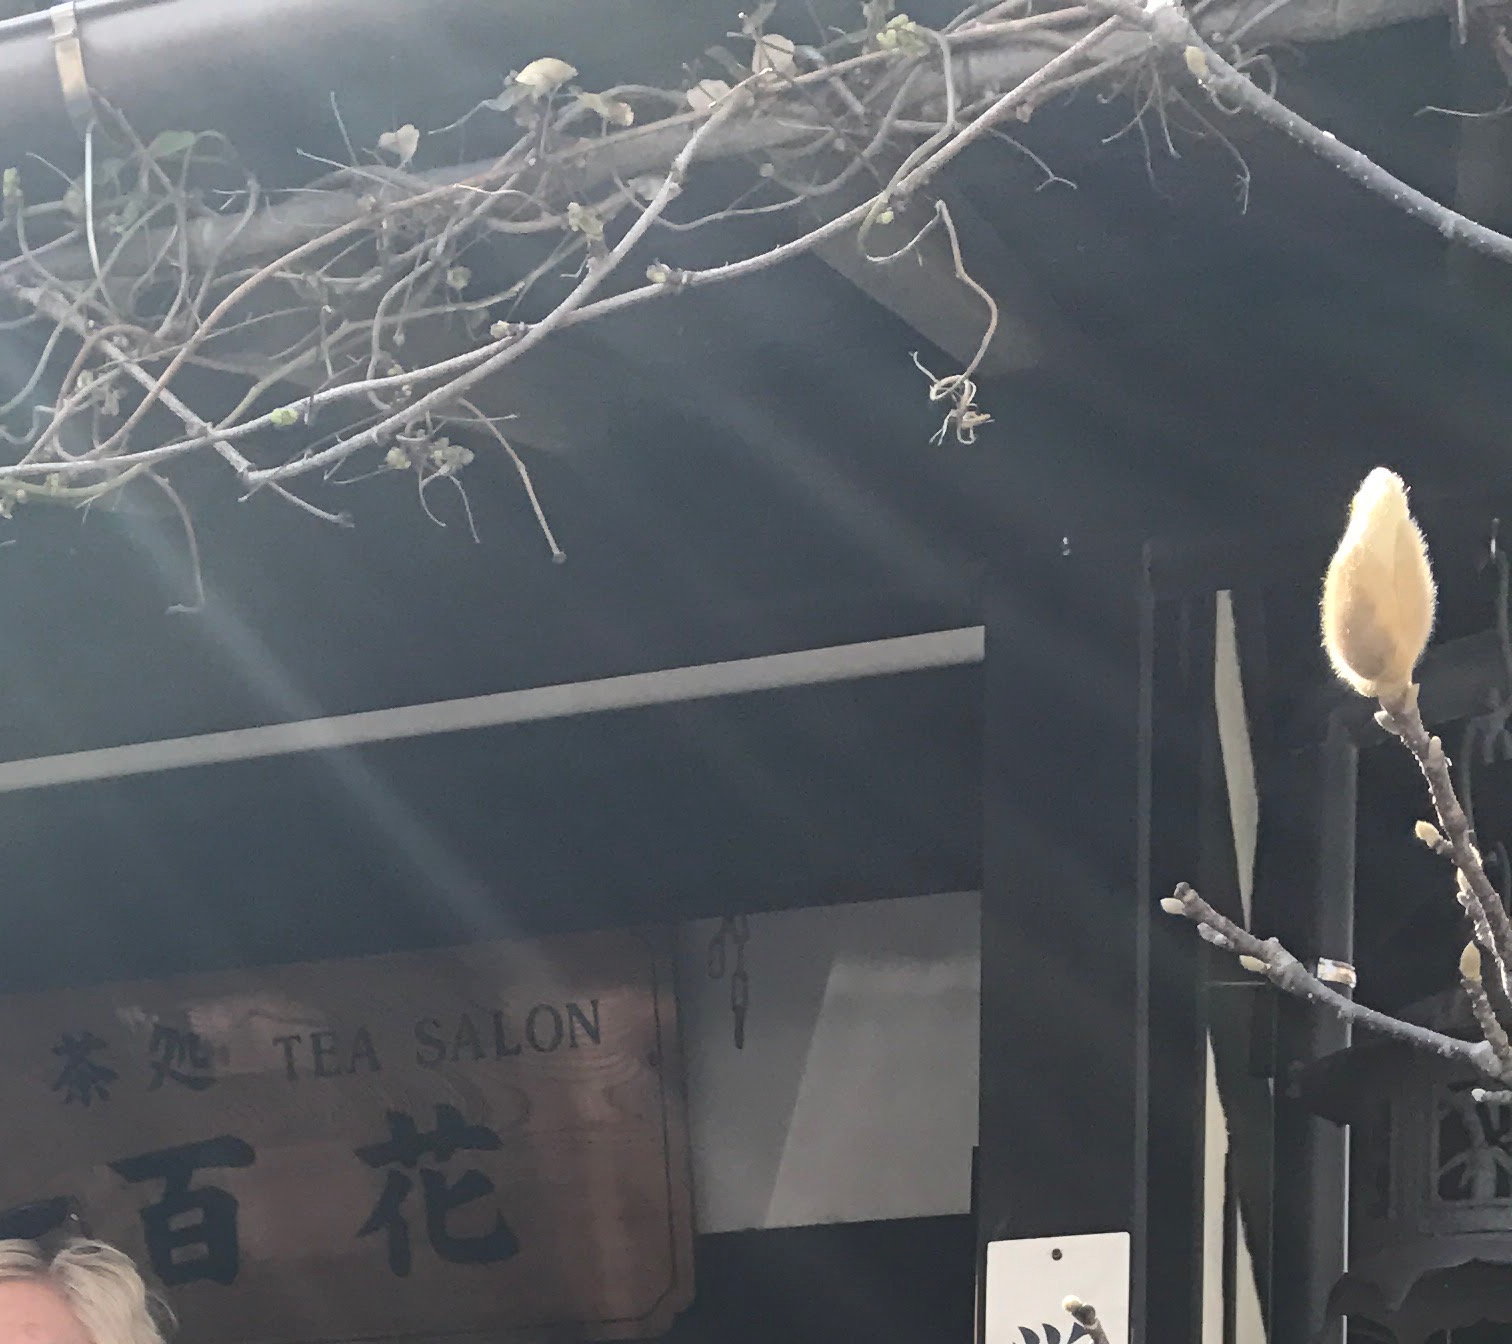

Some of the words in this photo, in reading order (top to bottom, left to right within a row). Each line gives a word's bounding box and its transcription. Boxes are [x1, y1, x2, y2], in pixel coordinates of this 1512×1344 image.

[272, 1025, 382, 1081] TEA
[414, 998, 602, 1068] SALON
[107, 1102, 521, 1287] 百花
